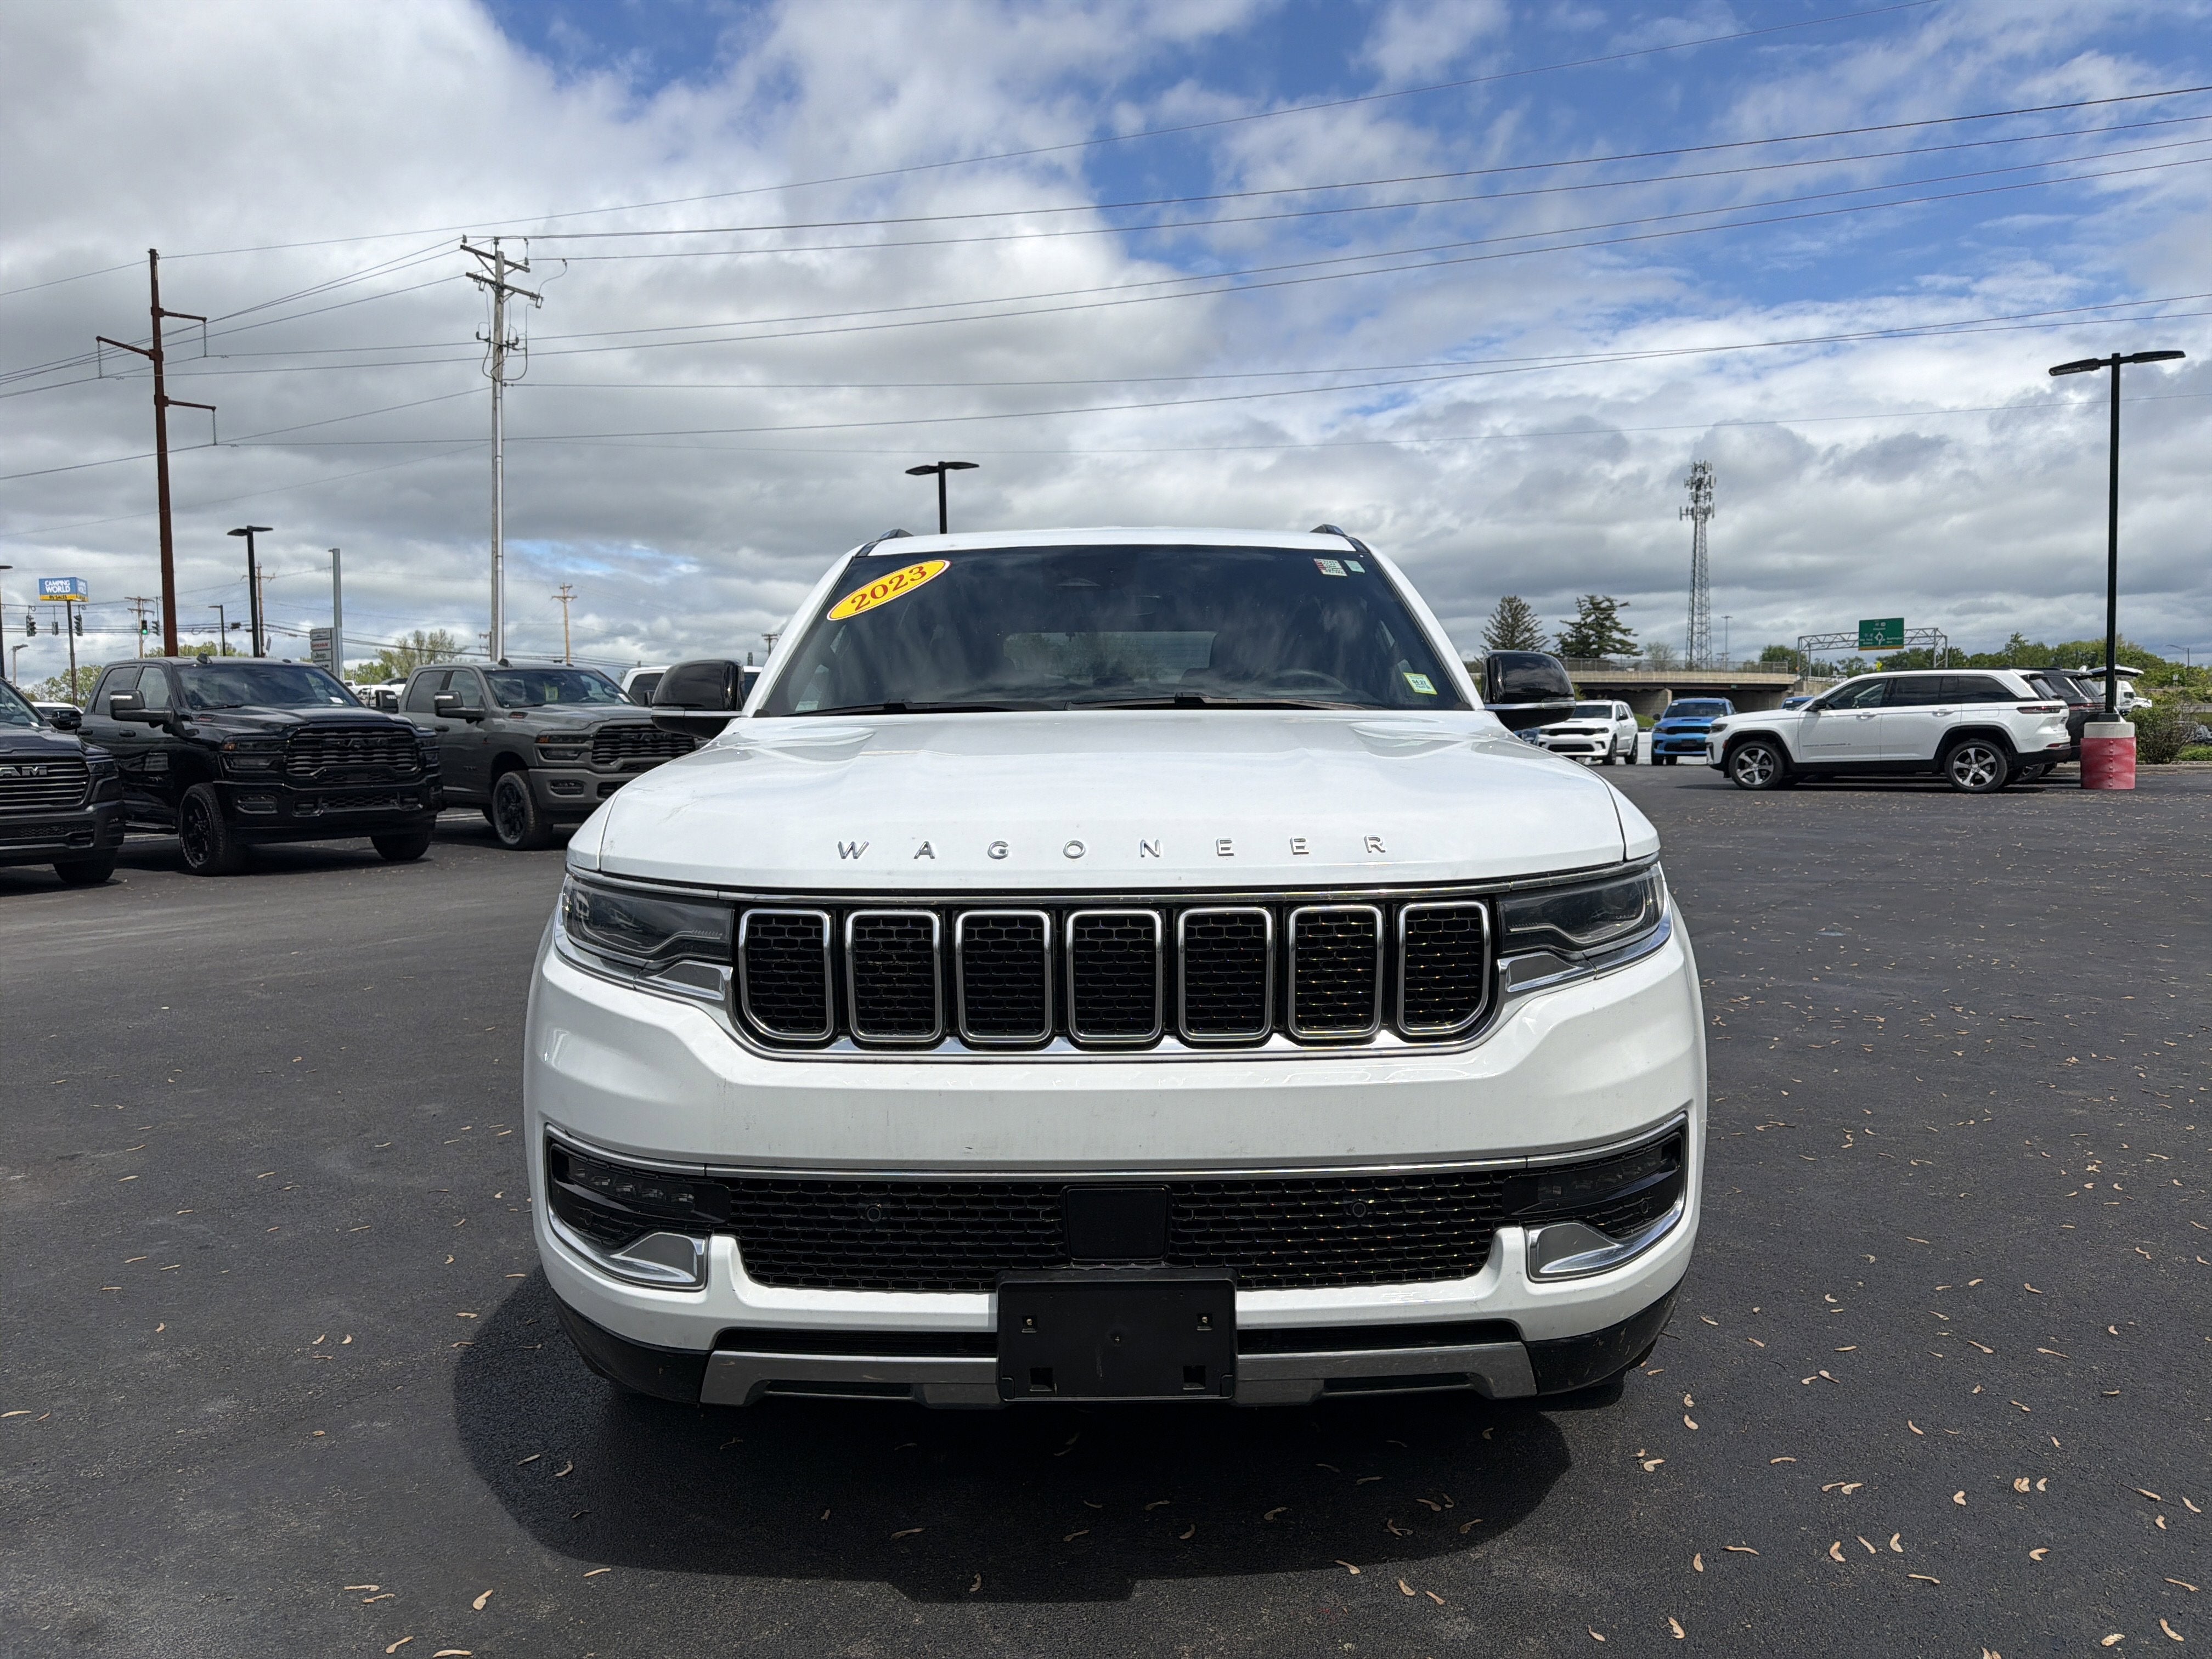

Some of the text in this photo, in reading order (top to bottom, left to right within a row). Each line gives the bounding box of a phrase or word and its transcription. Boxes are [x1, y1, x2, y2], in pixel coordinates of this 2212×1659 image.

[851, 566, 927, 611] 2023
[0, 766, 47, 776] AM
[838, 835, 1386, 860] WAGONEER
